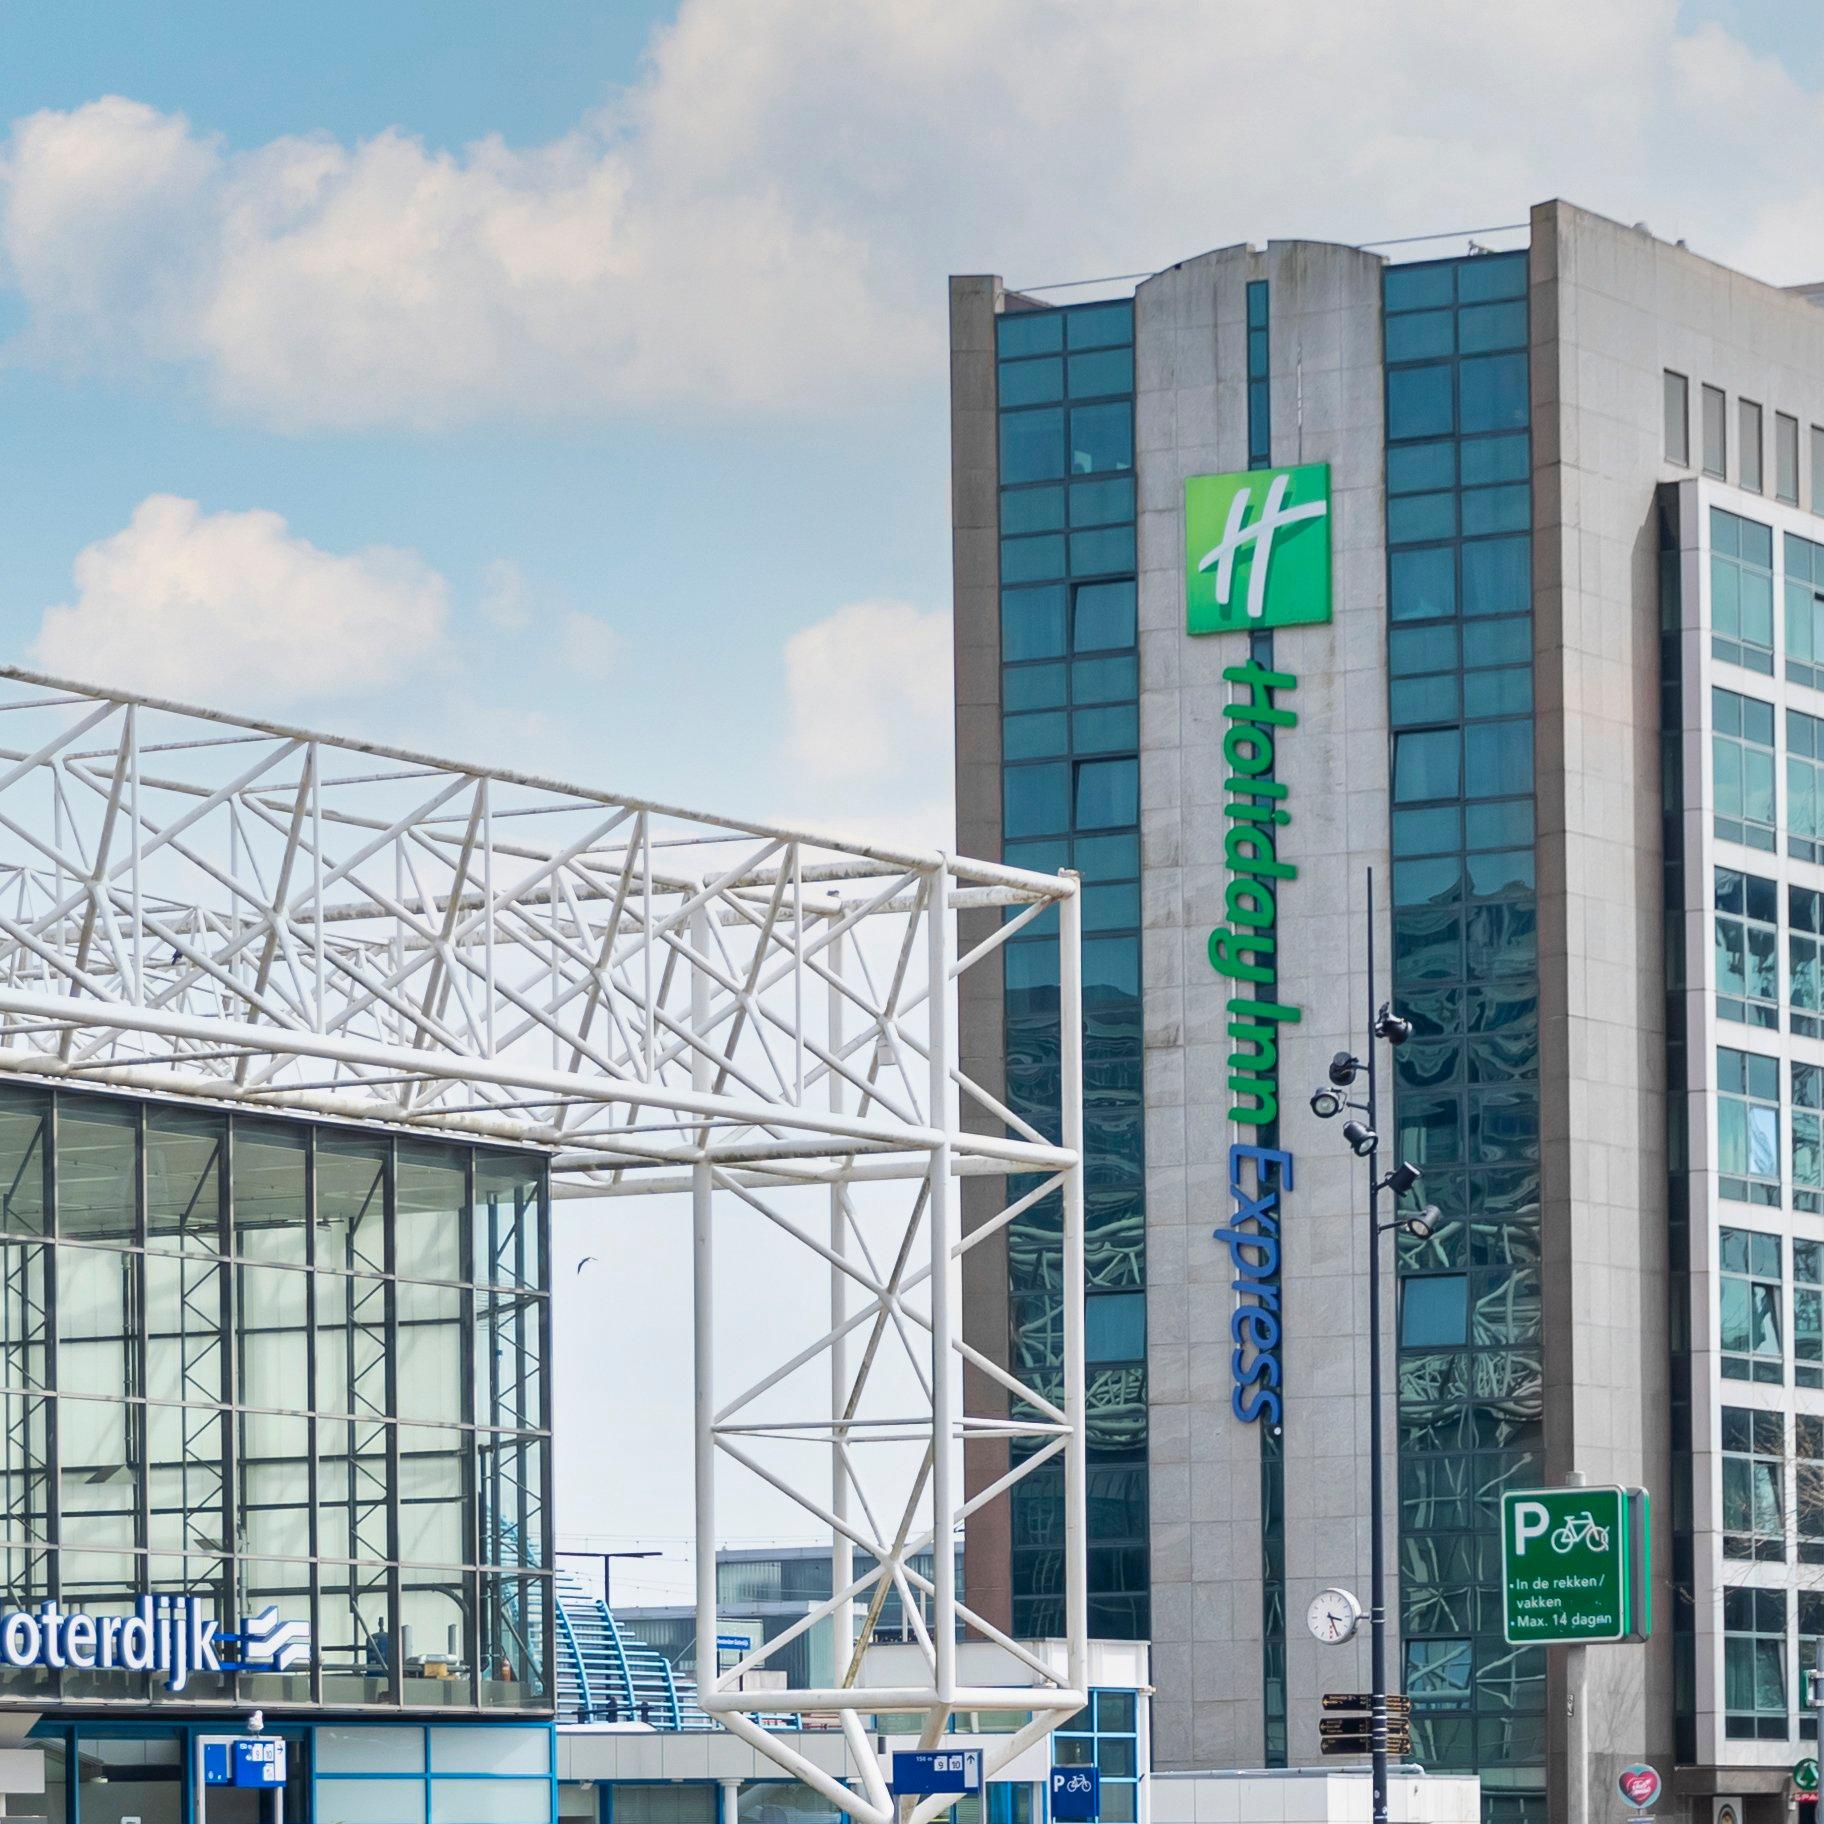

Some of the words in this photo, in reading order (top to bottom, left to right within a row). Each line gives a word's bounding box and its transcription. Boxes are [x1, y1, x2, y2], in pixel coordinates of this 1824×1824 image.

[1207, 659, 1299, 984] Holiday
[1226, 998, 1303, 1127] Inn
[1213, 1143, 1294, 1425] Express
[1514, 1501, 1550, 1556] P
[1516, 1578, 1529, 1590] In
[1532, 1576, 1550, 1590] de
[1516, 1596, 1562, 1609] vakken
[1517, 1615, 1548, 1628] Max.
[1552, 1612, 1567, 1626] 14
[1571, 1612, 1612, 1628] dagen
[951, 1760, 961, 1769] 10
[1053, 1775, 1065, 1792] P
